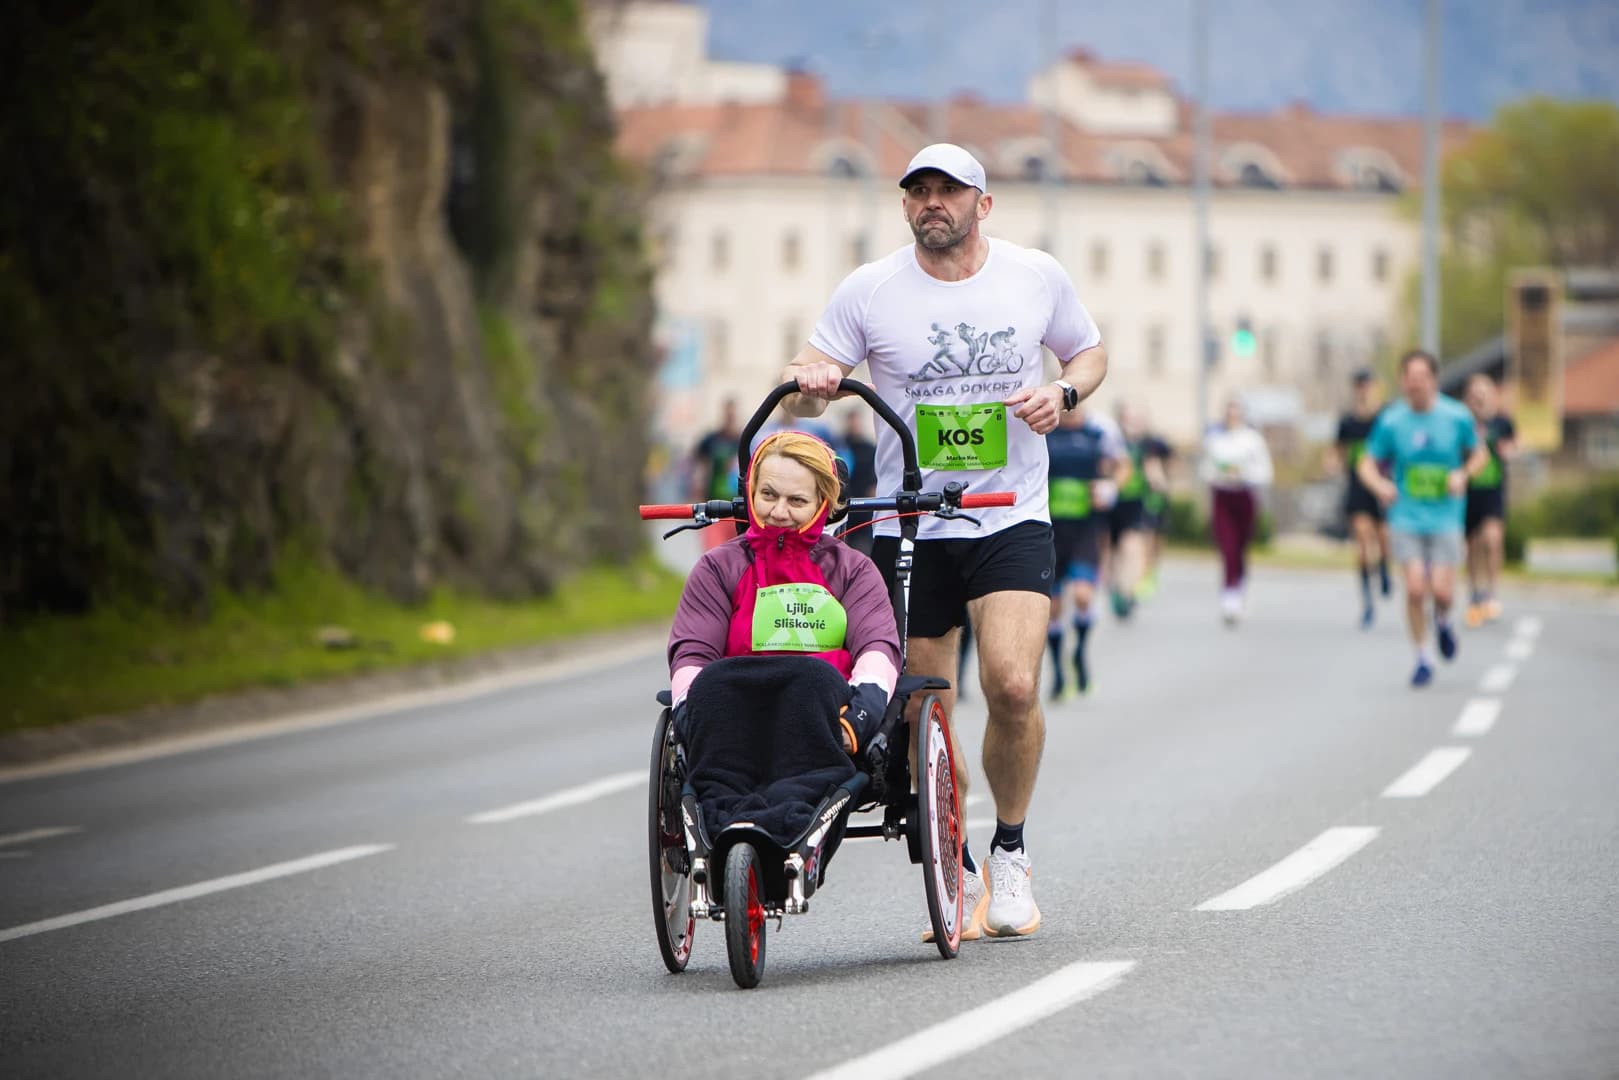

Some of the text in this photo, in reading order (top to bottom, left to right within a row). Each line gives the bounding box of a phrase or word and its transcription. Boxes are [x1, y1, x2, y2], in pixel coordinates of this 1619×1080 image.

[905, 385, 956, 399] SNAGA
[938, 428, 984, 446] KOS
[786, 603, 814, 615] Ljilja
[774, 618, 826, 630] Slišković
